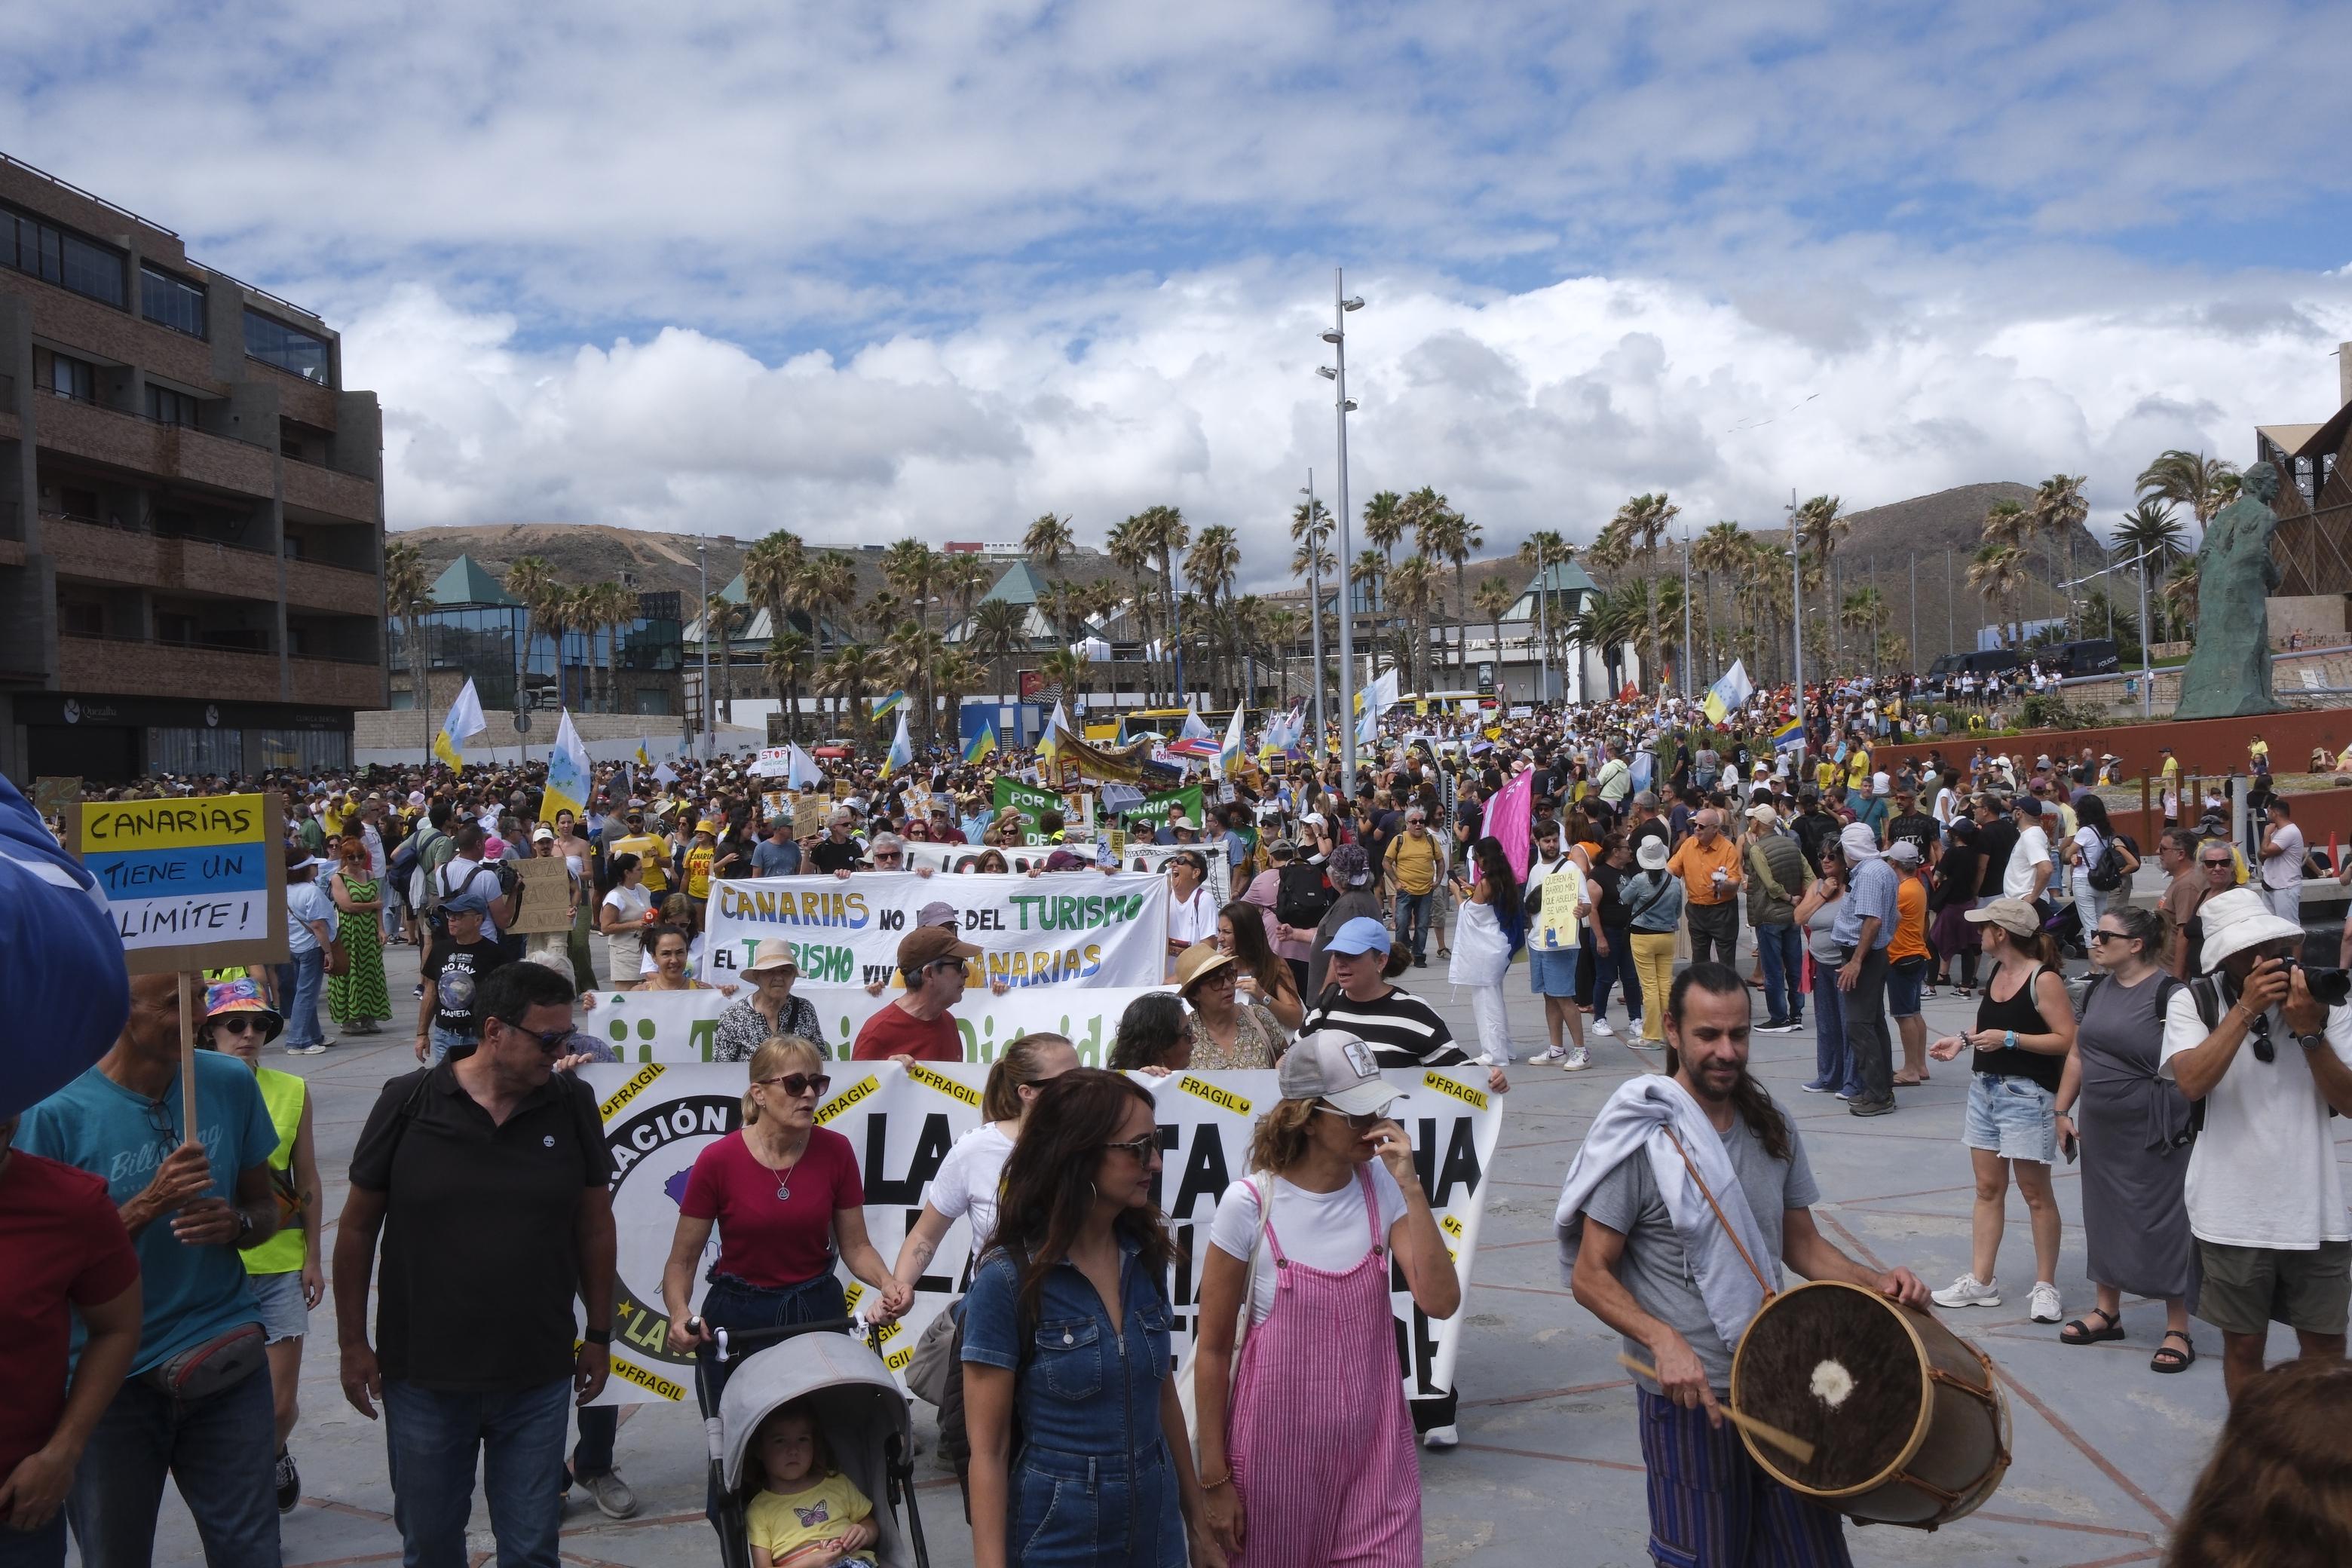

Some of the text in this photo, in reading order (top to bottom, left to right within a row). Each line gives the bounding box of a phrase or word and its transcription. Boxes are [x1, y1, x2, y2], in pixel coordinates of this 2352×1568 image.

[2097, 655, 2118, 669] POLICIA
[1011, 792, 1045, 808] POR
[104, 855, 243, 890] TIENE UN
[693, 861, 710, 869] NO
[1568, 873, 1575, 881] AL
[1545, 884, 1563, 896] BARRIO
[1556, 893, 1577, 903] ABUELITA
[721, 887, 870, 929] CANARIAS
[880, 909, 905, 931] NO
[966, 909, 1005, 931] DEL
[1009, 893, 1144, 930] TURISMO
[1547, 905, 1568, 915] SE VAYA
[441, 963, 476, 975] NO HAY
[714, 948, 737, 970] EL
[971, 945, 1101, 988] ANARIAS
[612, 1063, 666, 1109] FRAGIL
[819, 1080, 876, 1123] FRAGIL
[923, 1072, 978, 1106] FRAGIL
[1180, 1076, 1234, 1110] FRAGIL
[1435, 1078, 1483, 1107] FRAGIL
[624, 1309, 668, 1353] LA
[625, 1364, 681, 1401] FRAGIL
